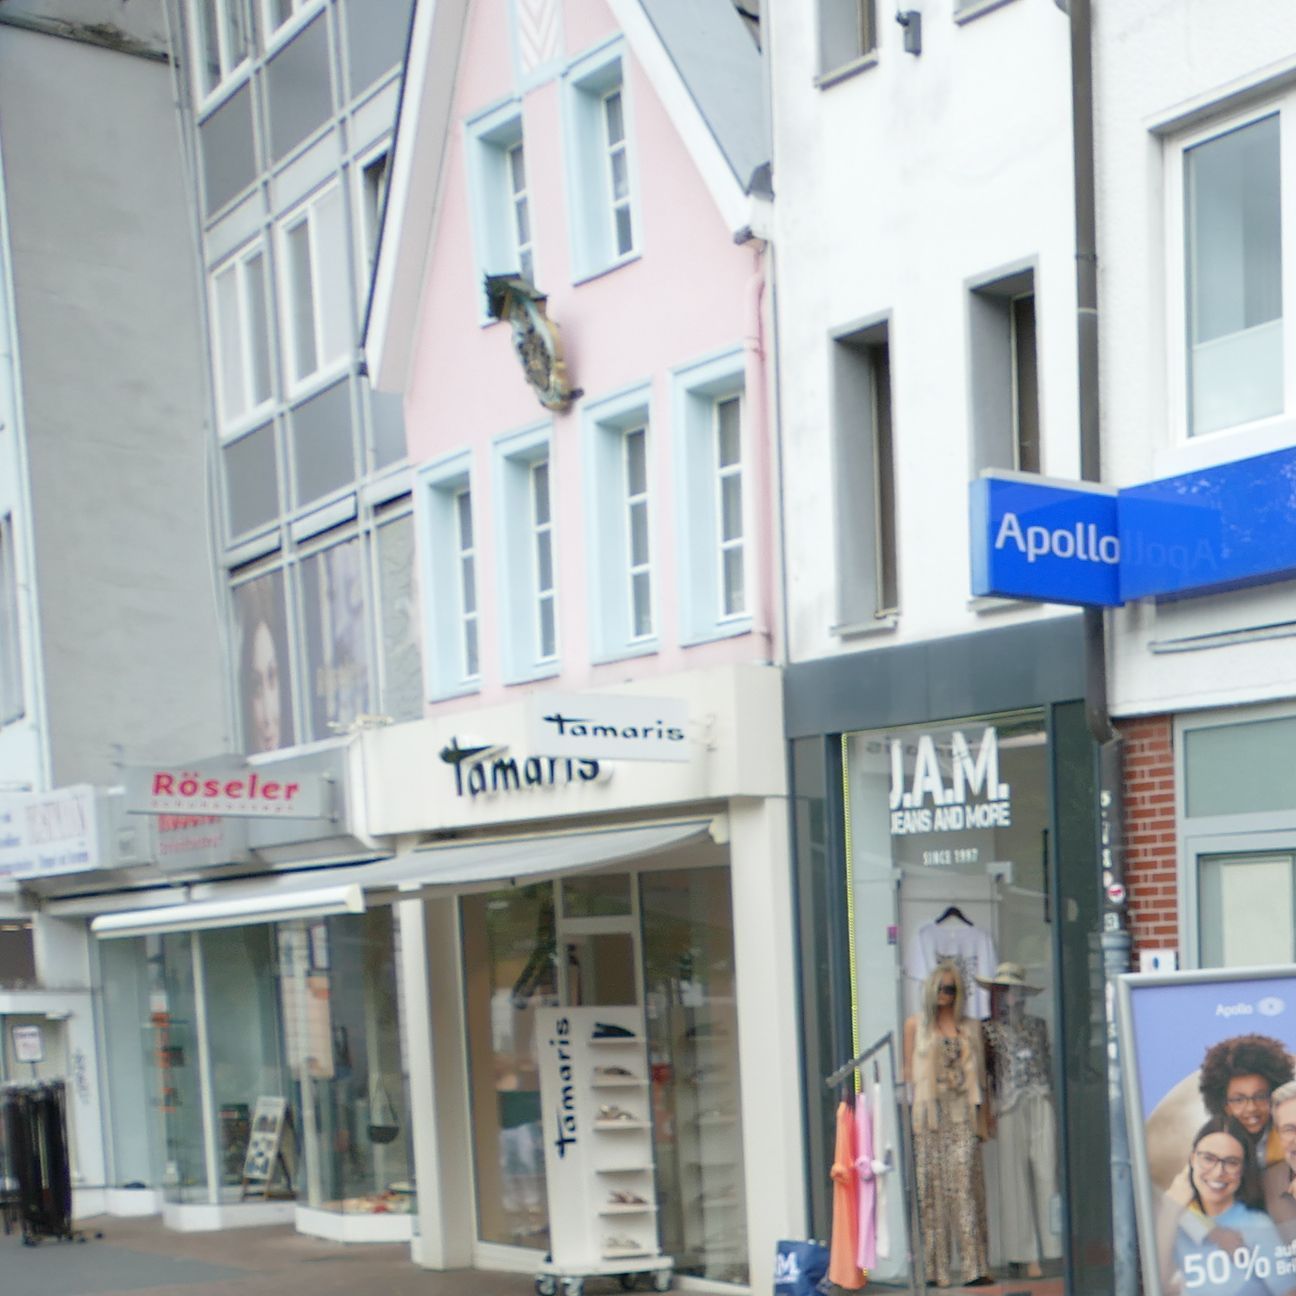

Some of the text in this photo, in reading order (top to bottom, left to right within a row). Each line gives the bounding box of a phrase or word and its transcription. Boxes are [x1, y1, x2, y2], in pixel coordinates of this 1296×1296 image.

[995, 512, 1120, 564] Apollo
[151, 770, 301, 802] Röseler
[889, 727, 1010, 811] J.A.M.
[890, 801, 1012, 836] JEANS AND MORE
[1215, 1002, 1253, 1018] Apollo
